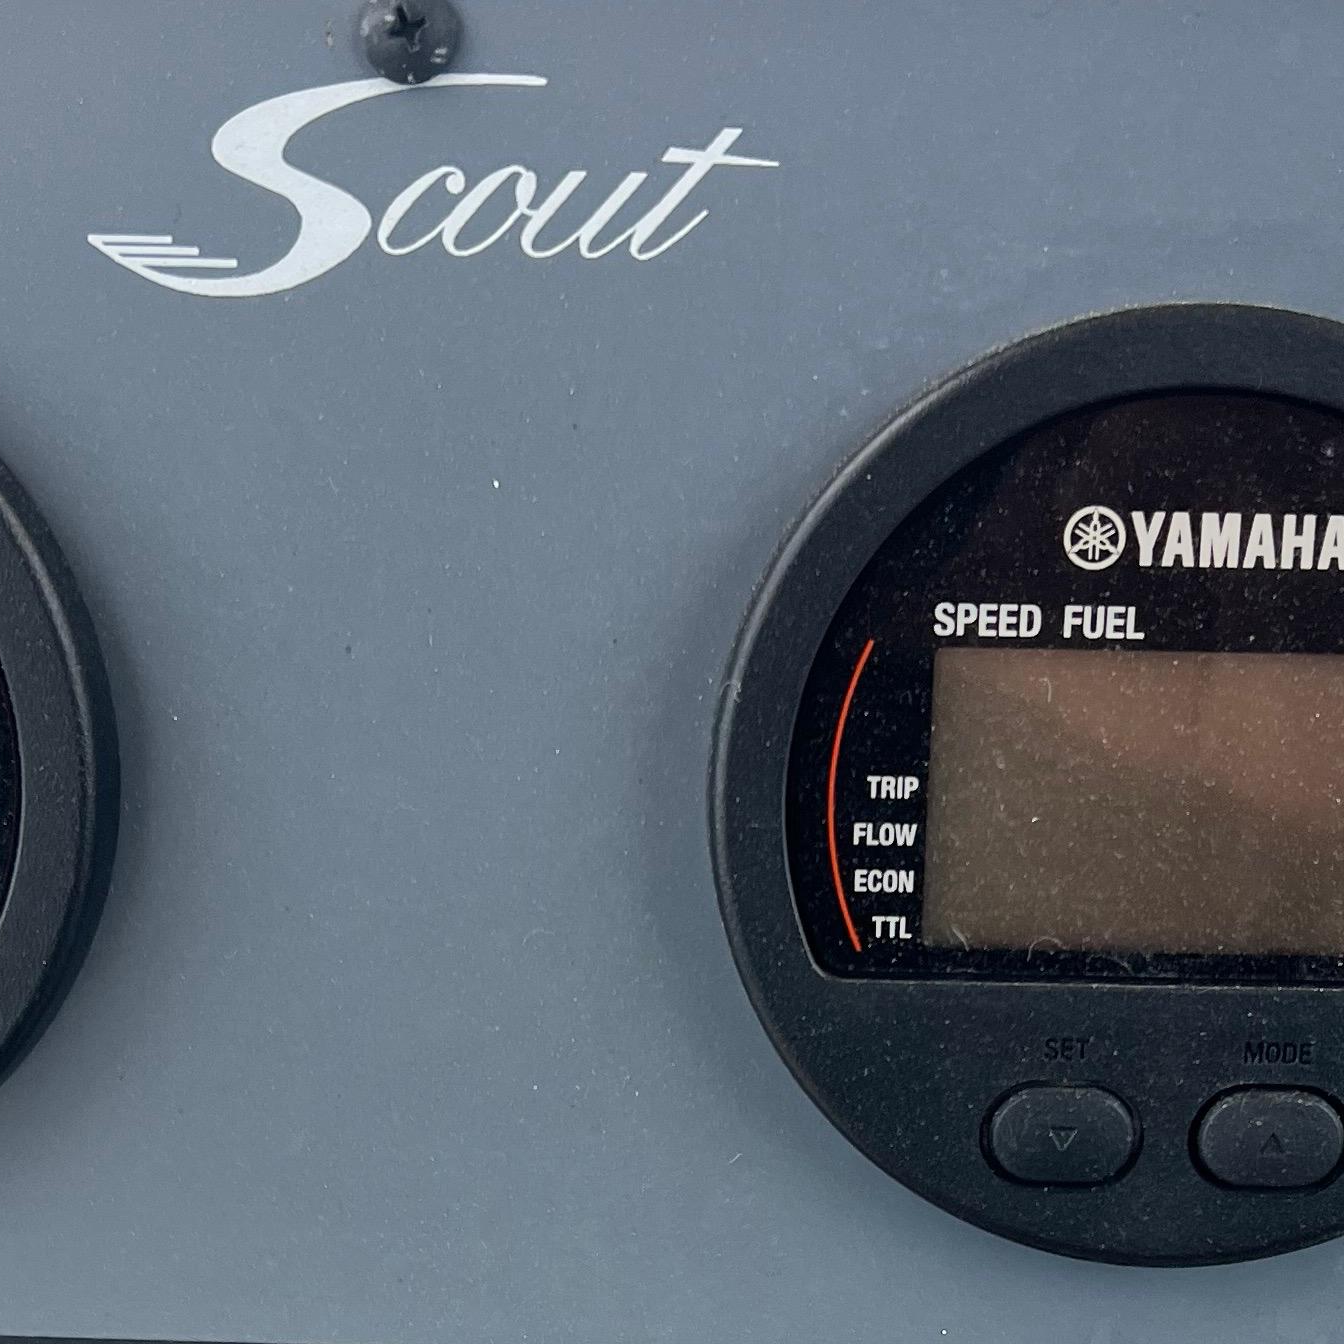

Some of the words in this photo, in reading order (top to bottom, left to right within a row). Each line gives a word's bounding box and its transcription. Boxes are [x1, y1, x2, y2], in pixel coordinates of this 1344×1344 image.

[87, 73, 780, 297] Scout
[933, 602, 1042, 638] SPEED
[1063, 604, 1146, 640] FUEL
[866, 775, 919, 800] TRIP
[853, 822, 918, 847] FLOW
[854, 869, 915, 894] ECON
[871, 915, 913, 939] TTL
[1044, 1037, 1089, 1061] SET
[1244, 1040, 1312, 1065] MODE
